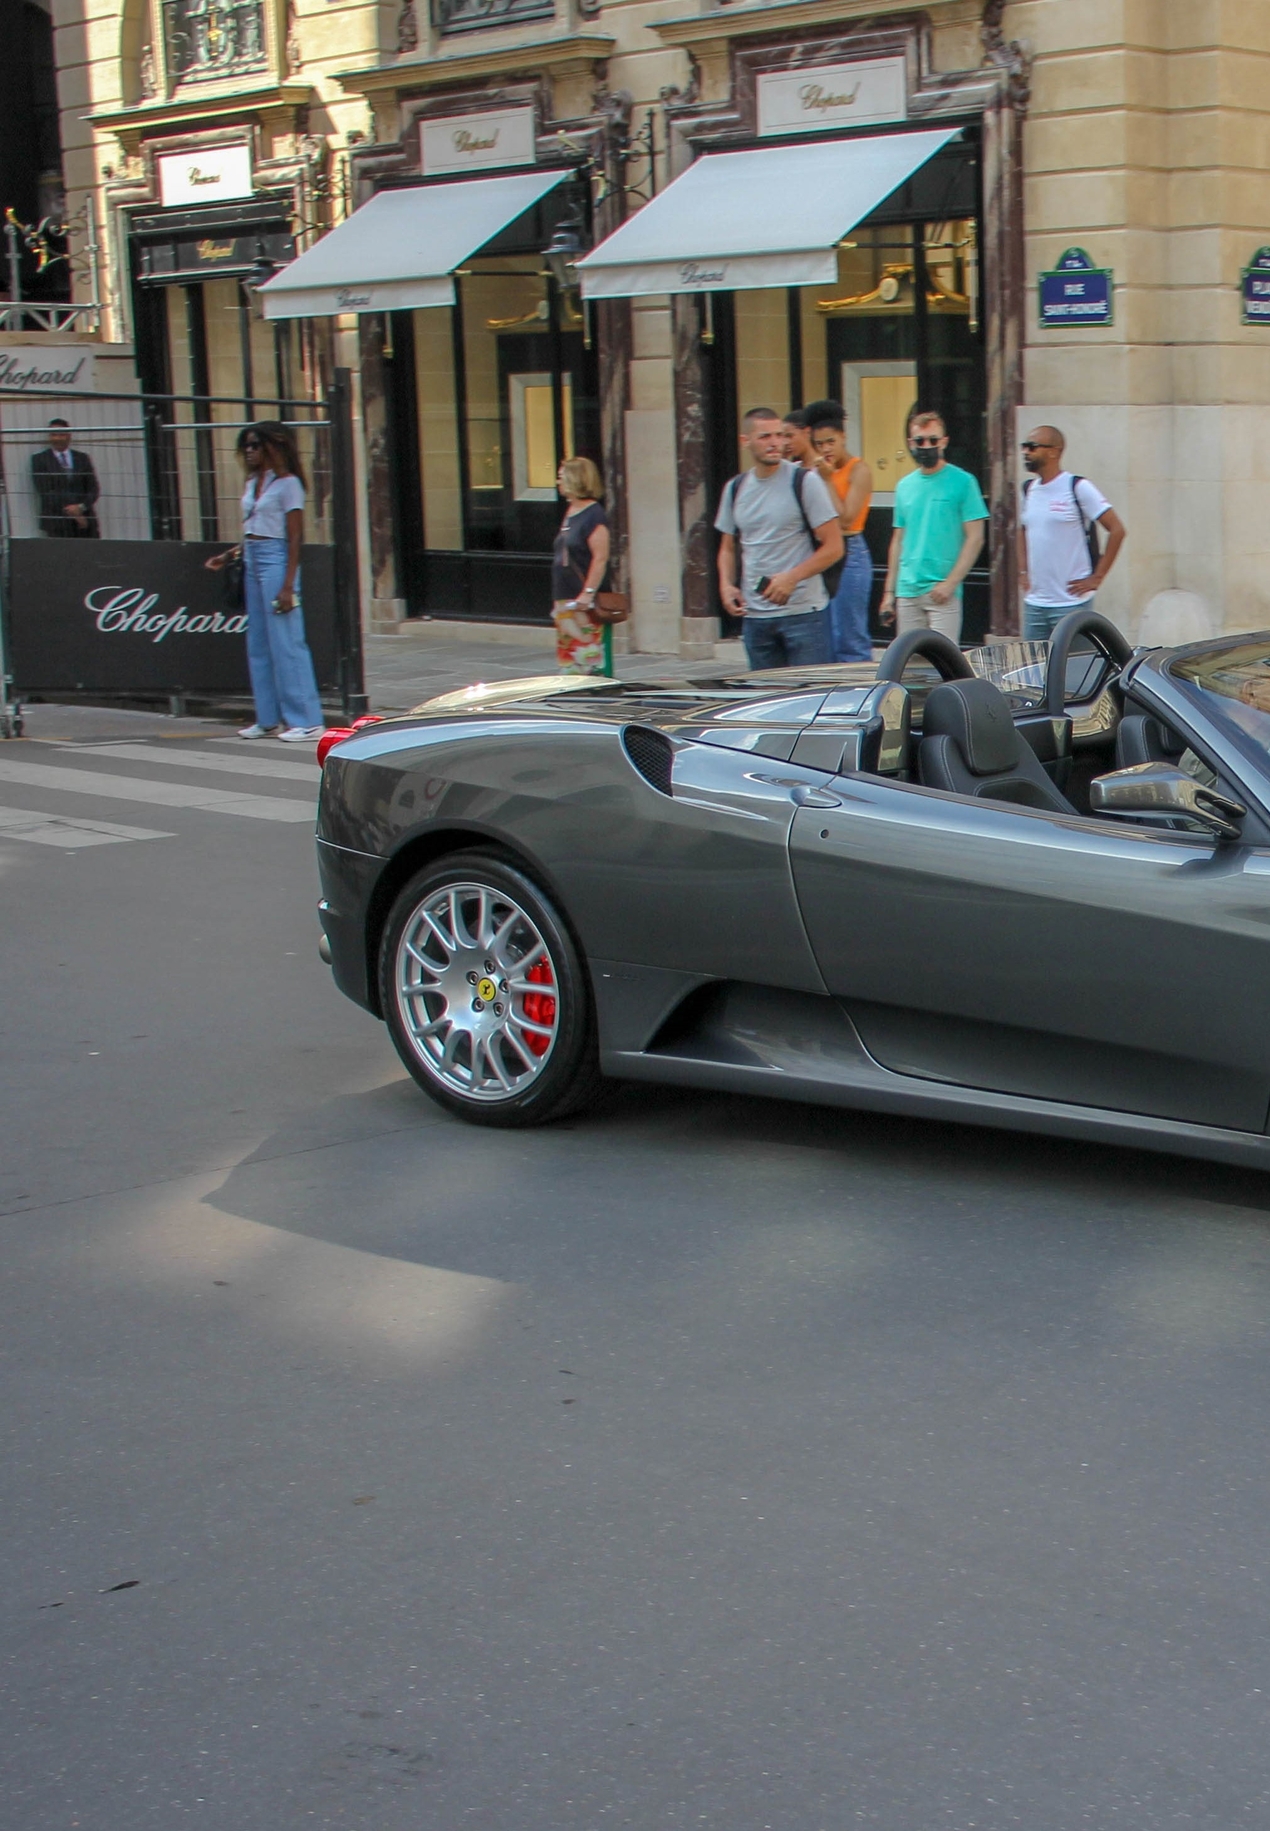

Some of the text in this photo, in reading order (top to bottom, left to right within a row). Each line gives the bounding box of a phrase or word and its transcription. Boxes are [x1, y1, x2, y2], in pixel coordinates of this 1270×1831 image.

[799, 81, 860, 113] Chopard
[453, 128, 500, 155] Chopard
[0, 354, 86, 389] hopard
